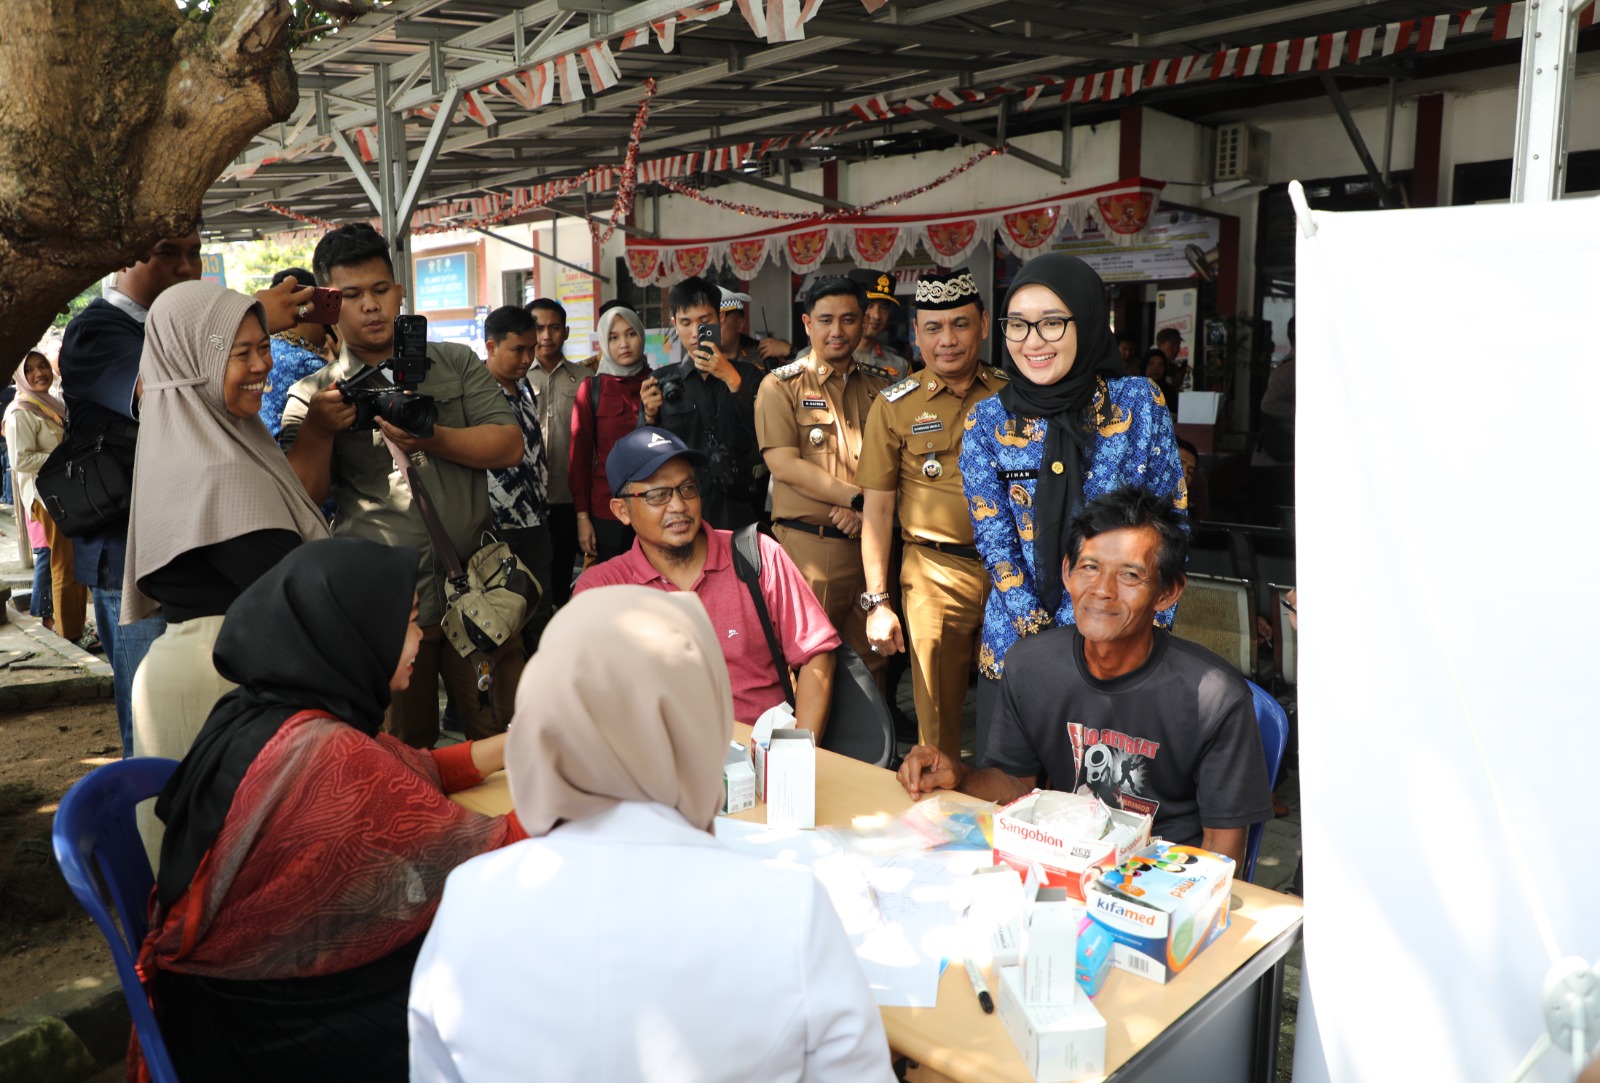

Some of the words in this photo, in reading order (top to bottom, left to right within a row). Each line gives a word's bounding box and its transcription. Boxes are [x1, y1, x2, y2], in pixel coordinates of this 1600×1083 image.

[1101, 728, 1160, 759] RETREAT
[999, 817, 1063, 848] Sangobion
[1073, 846, 1092, 856] NEW
[1096, 897, 1156, 926] kifamed
